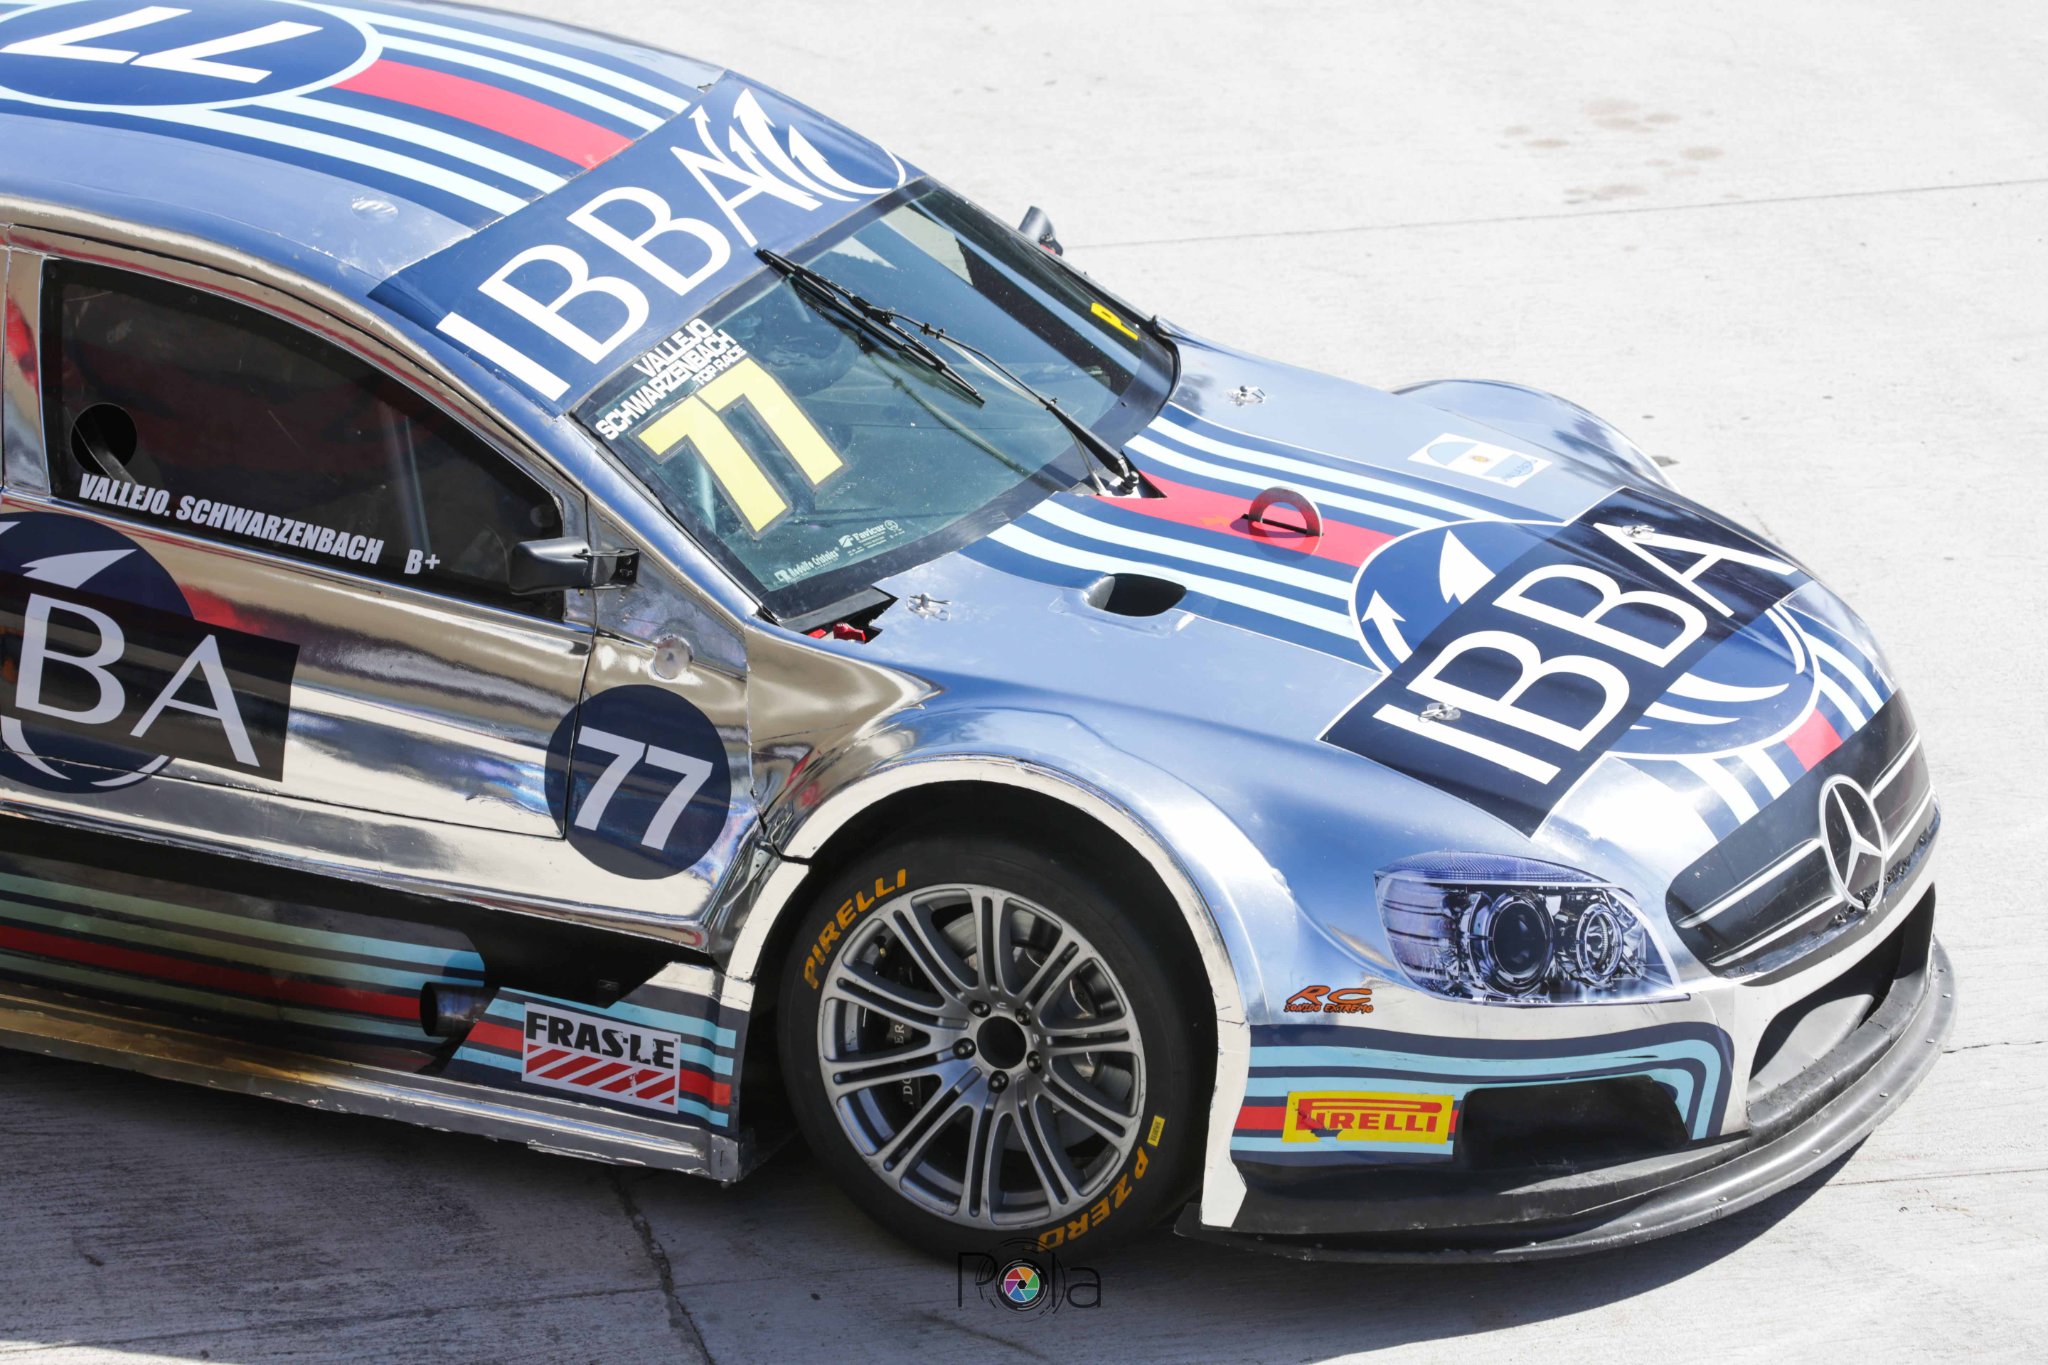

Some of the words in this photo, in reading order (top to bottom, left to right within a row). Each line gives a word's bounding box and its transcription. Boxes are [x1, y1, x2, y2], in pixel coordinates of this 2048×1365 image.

[437, 146, 822, 402] IBBA
[595, 329, 737, 440] SCHWARZENBACH
[633, 318, 713, 378] VALLEJO
[691, 364, 715, 386] TOP
[713, 345, 747, 371] RACE
[638, 357, 843, 532] 77
[176, 495, 384, 564] SCHWARZENBACH
[404, 549, 440, 575] B+
[1373, 522, 1798, 785] IBBA
[574, 726, 713, 850] 77
[804, 868, 906, 989] PIRELLI
[1286, 985, 1373, 1005] RC
[1323, 1003, 1375, 1014] EXTREMO
[1296, 1099, 1442, 1133] PIRELLI
[1135, 1147, 1149, 1179] P
[1036, 1173, 1132, 1252] ZERO
